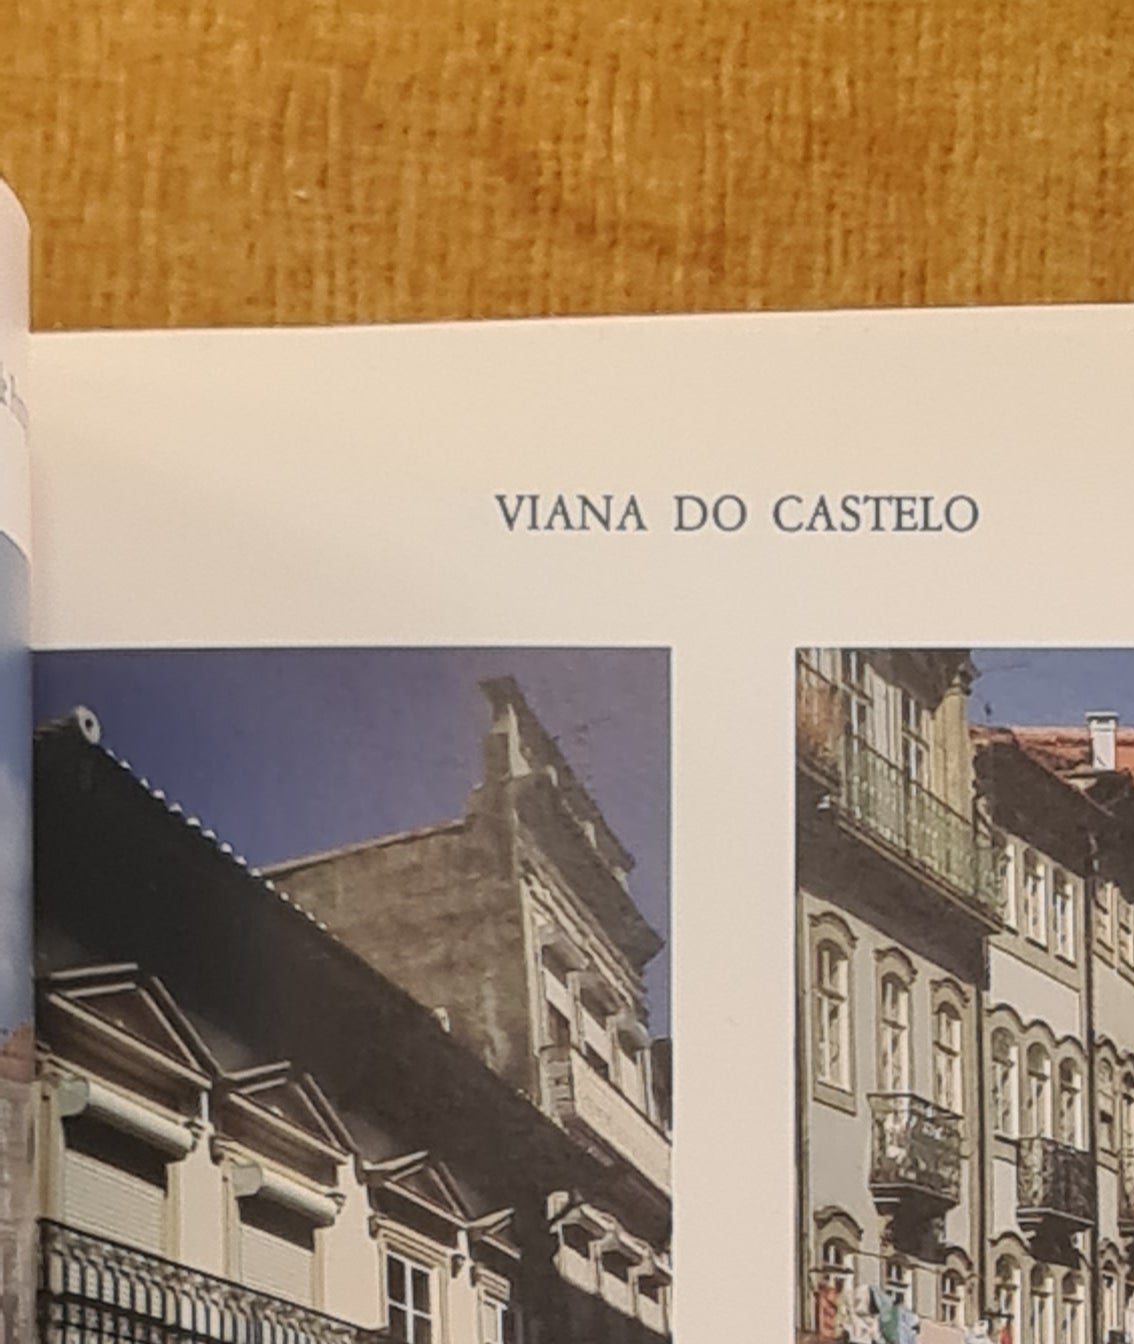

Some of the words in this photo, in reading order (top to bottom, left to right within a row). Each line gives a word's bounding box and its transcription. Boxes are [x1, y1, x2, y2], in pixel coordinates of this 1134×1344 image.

[494, 493, 649, 532] VIANA
[673, 494, 748, 533] DO
[772, 494, 980, 534] CASTELO
